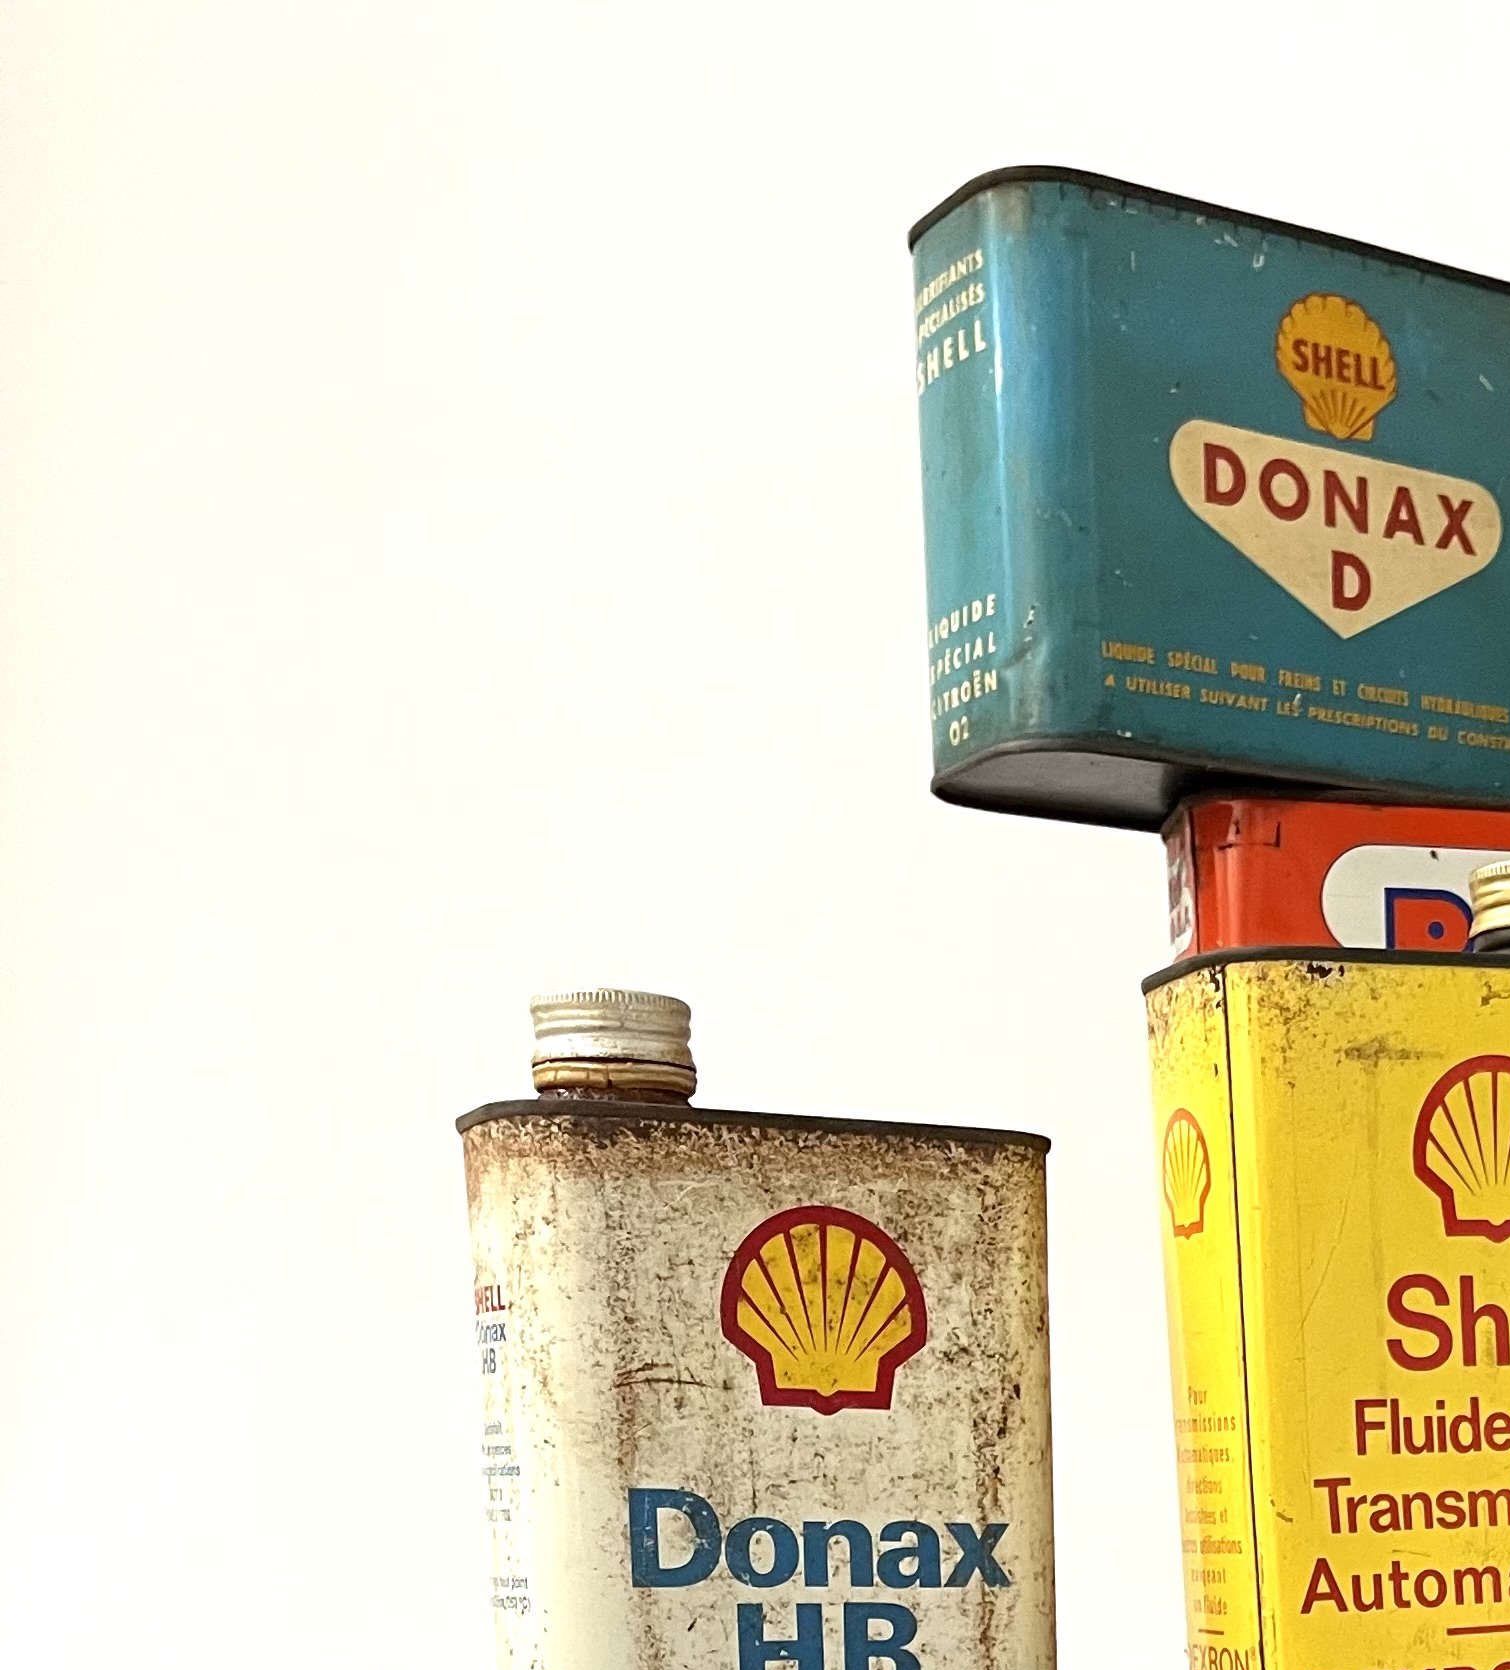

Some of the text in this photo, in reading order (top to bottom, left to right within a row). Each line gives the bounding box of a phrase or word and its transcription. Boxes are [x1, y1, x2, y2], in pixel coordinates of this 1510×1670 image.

[1291, 338, 1386, 391] SHELL
[1202, 442, 1478, 556] DONAX
[1331, 549, 1371, 612] D
[928, 594, 997, 650] LIQUIDE
[1126, 676, 1191, 699] UTILISER
[1200, 688, 1270, 712] SUIVANT
[626, 1487, 1011, 1589] Donax
